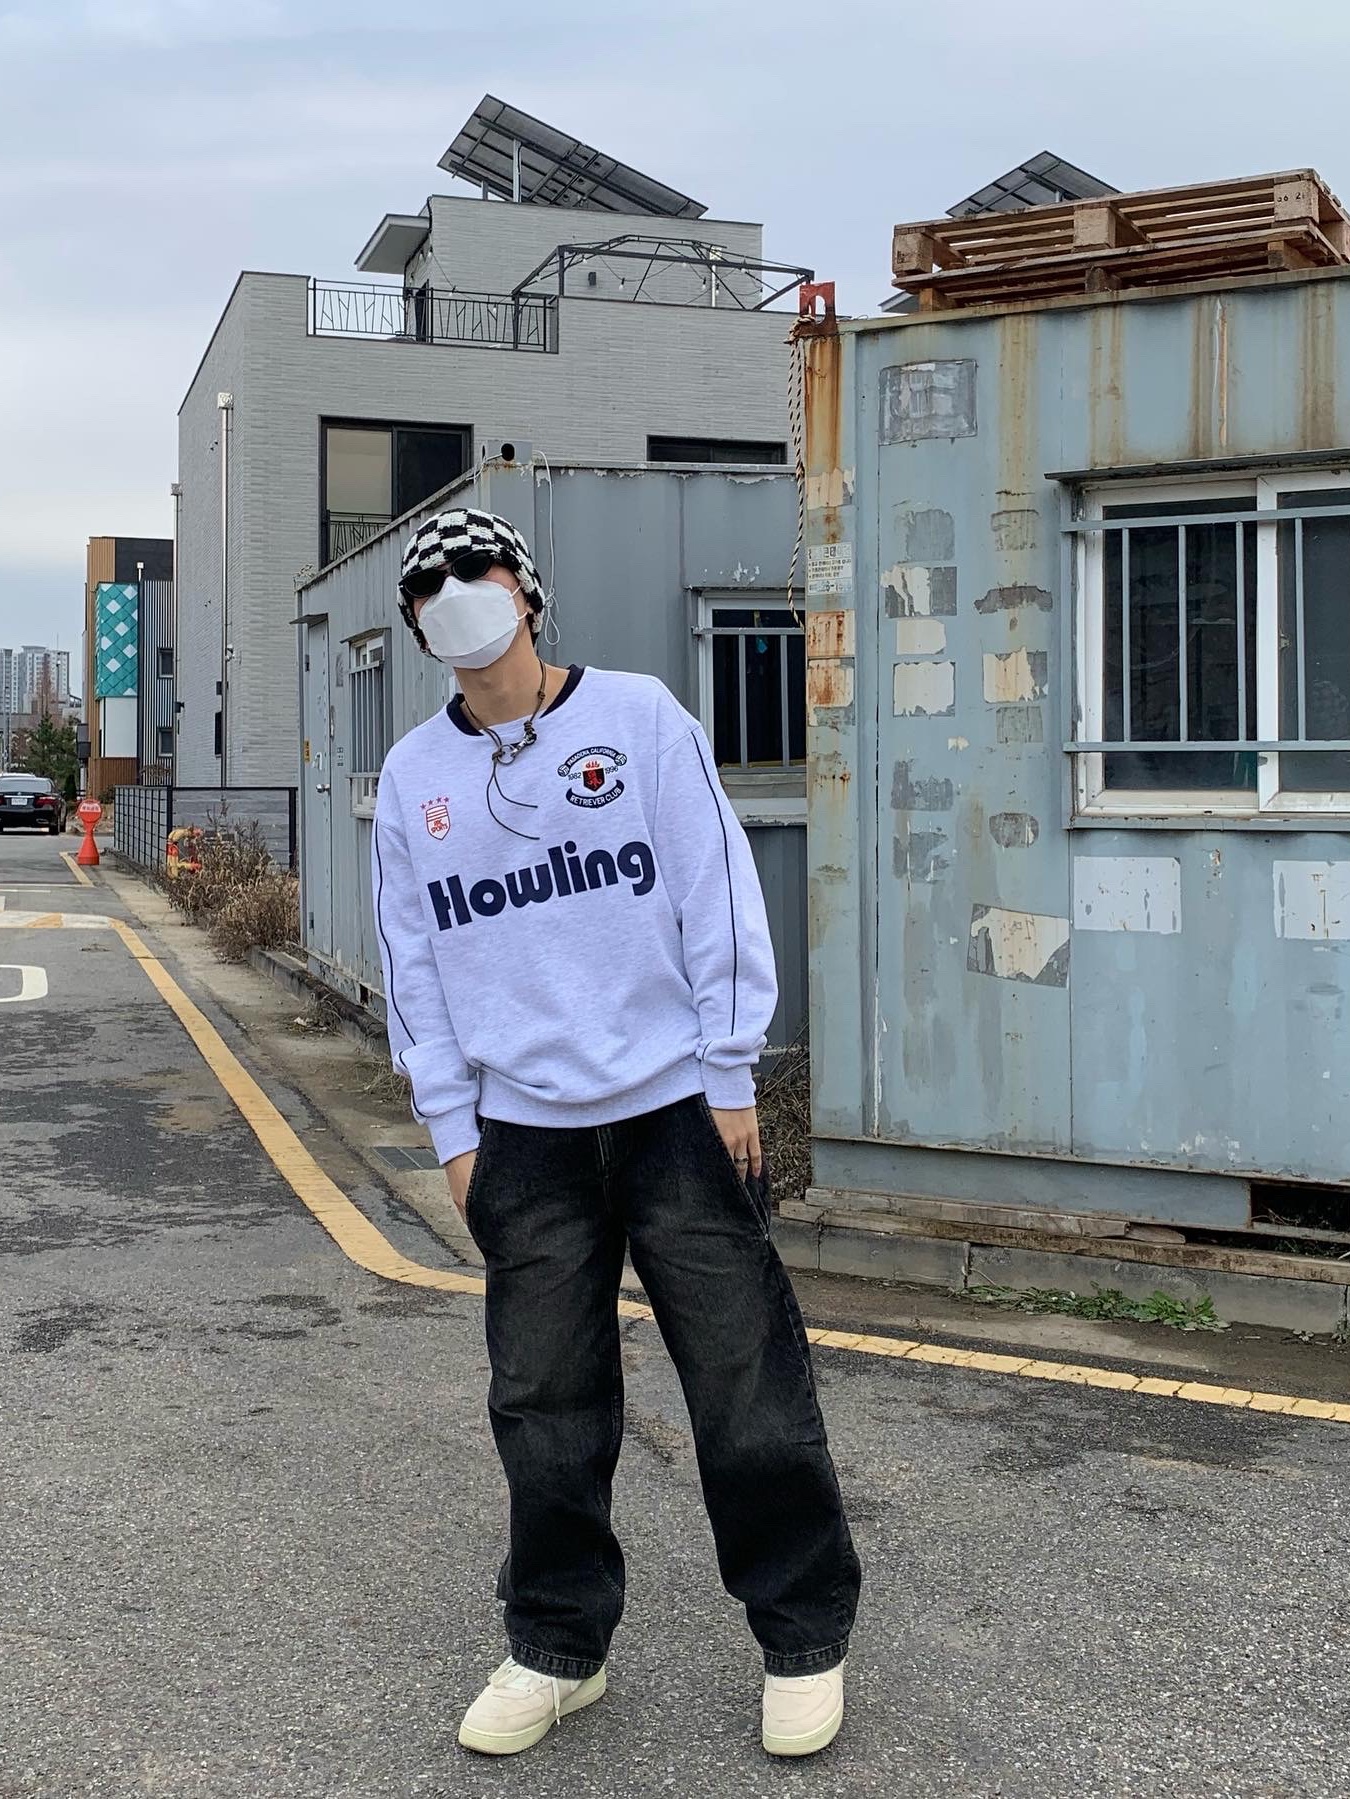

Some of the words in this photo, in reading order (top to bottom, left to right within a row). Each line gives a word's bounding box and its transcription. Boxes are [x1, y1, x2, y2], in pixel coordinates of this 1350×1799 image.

[567, 749, 590, 766] PASADENA
[590, 747, 616, 758] CALIFORNIA
[569, 794, 606, 806] RETRIEVER
[605, 787, 622, 801] CLUB
[427, 840, 656, 931] Howling
